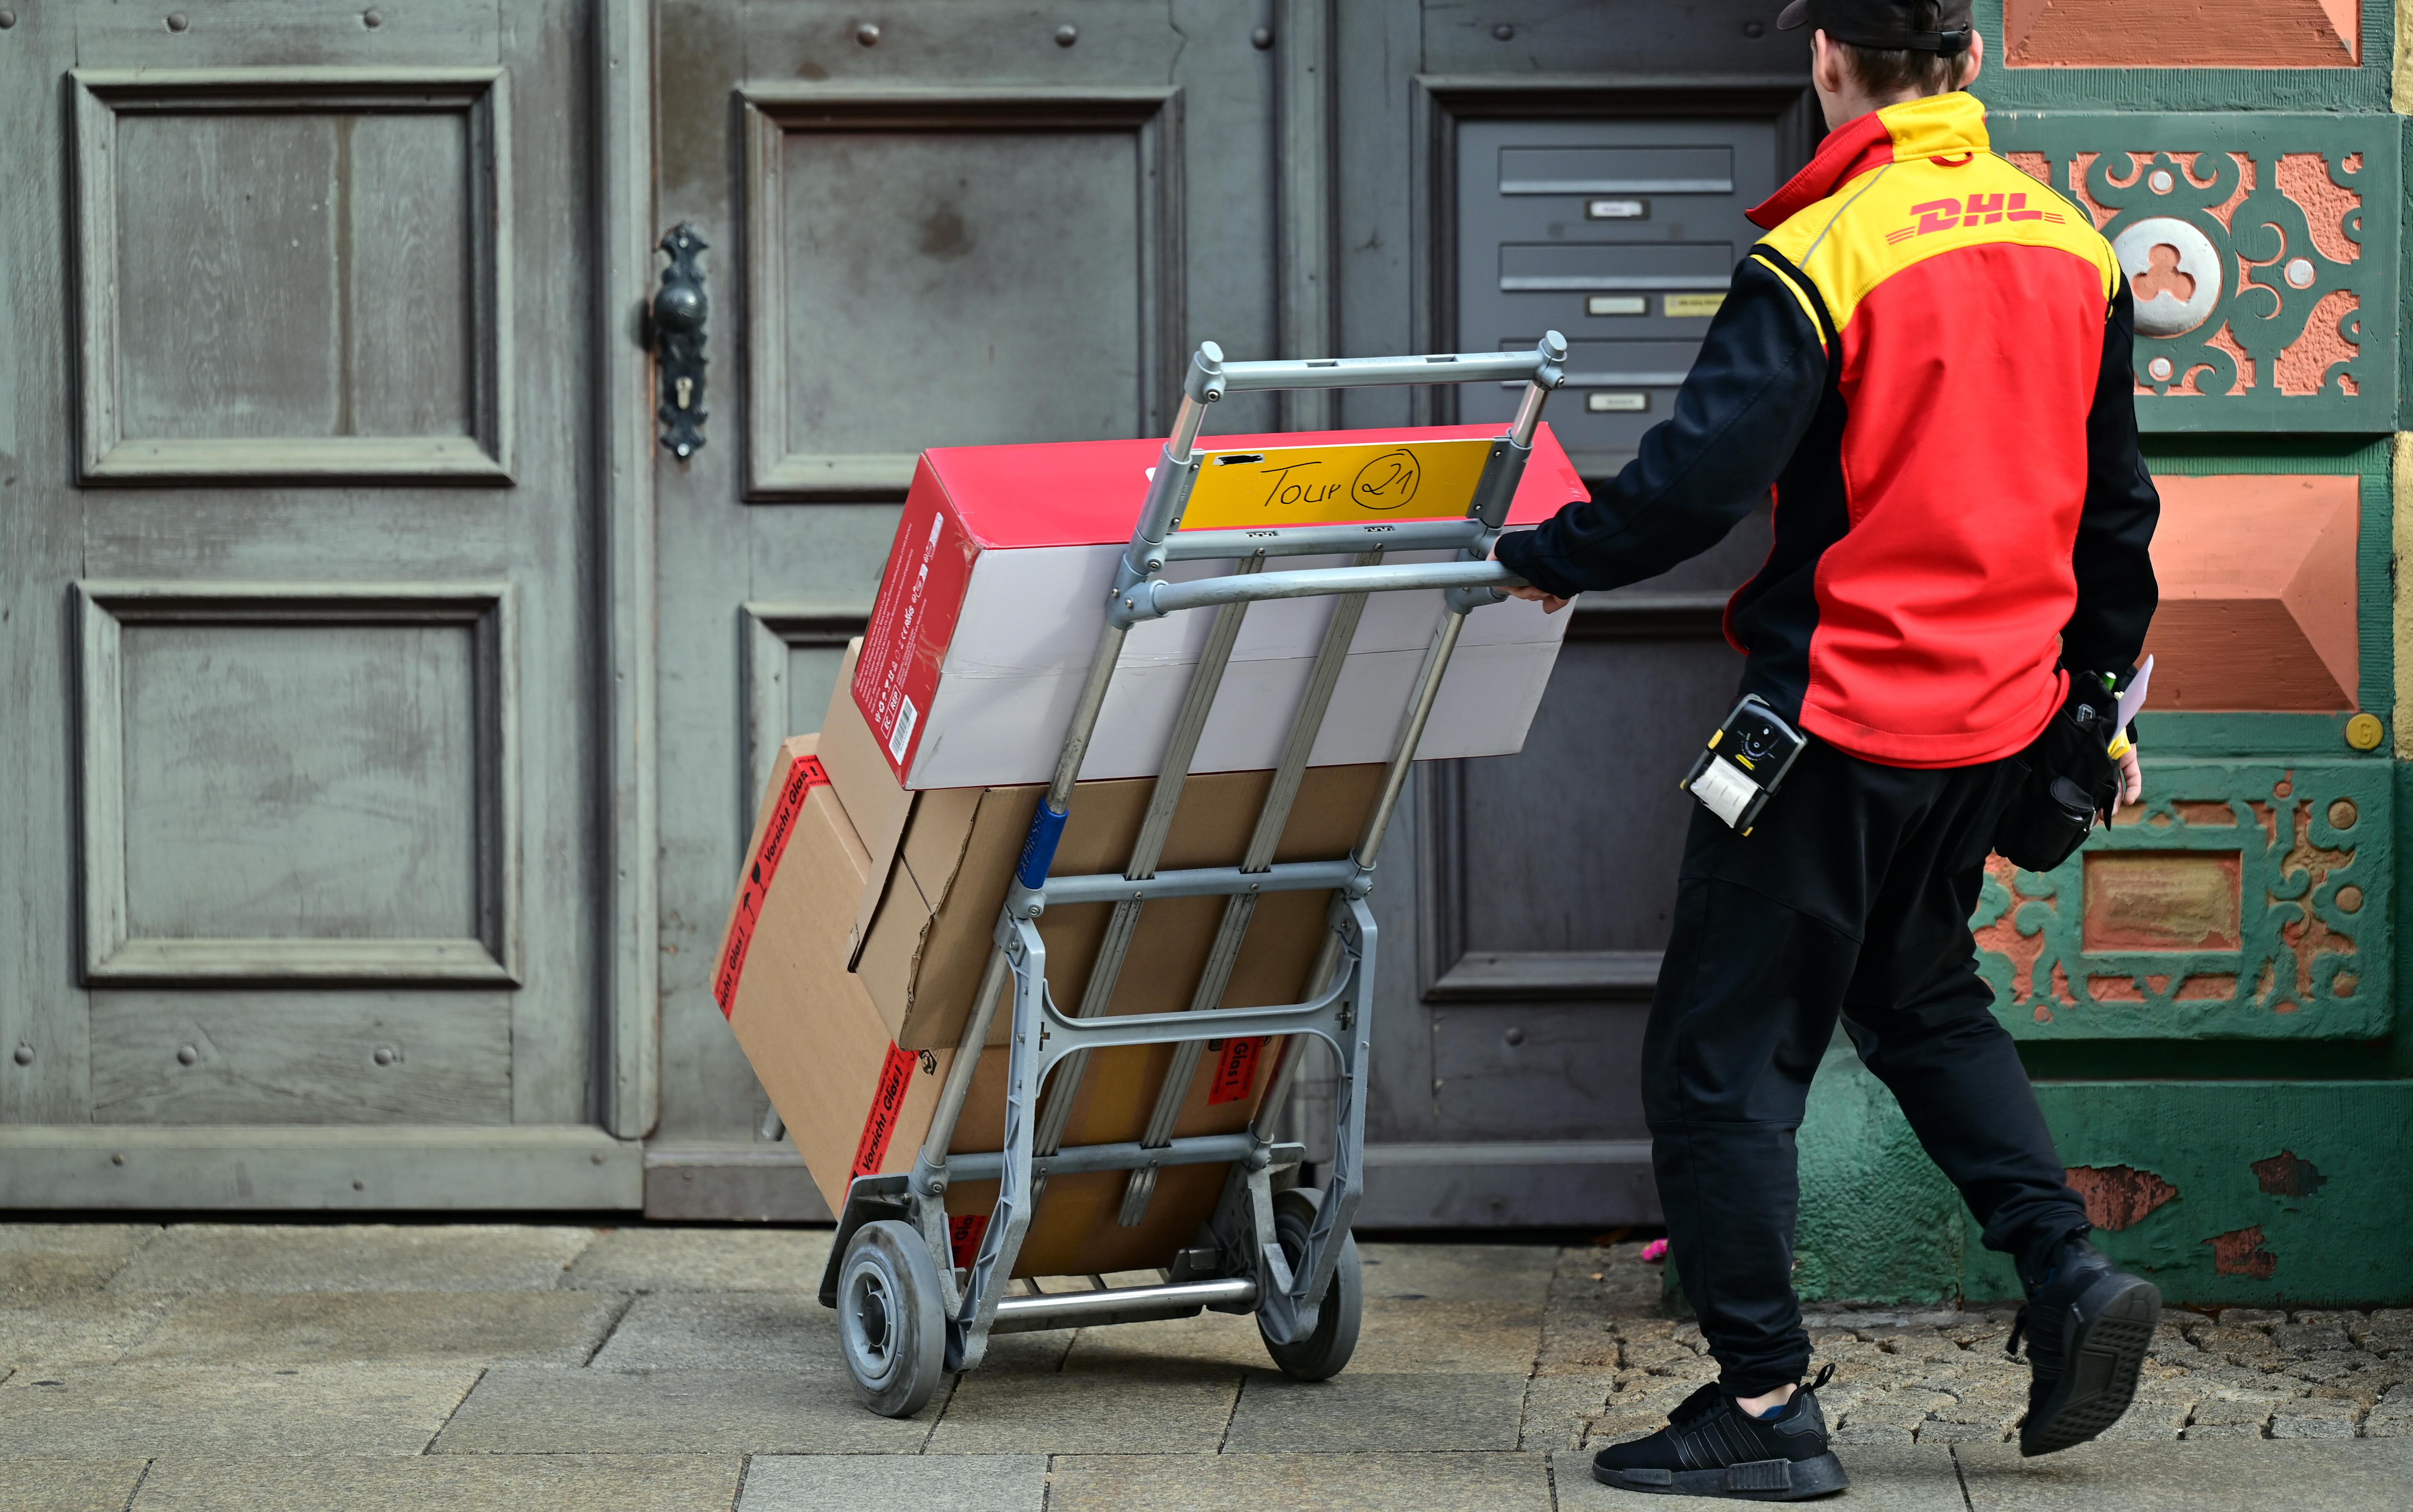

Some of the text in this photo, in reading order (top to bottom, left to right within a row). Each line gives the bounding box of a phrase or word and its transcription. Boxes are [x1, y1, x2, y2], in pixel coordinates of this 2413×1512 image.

[1910, 193, 2042, 236] DHL
[1261, 462, 1413, 507] Tour 21
[884, 691, 898, 730] EC REP
[765, 808, 790, 864] Vorsicht
[789, 770, 808, 806] Glas
[729, 937, 743, 971] Glas
[1228, 1043, 1249, 1078] Glas
[862, 1113, 886, 1171] Vorsicht
[884, 1074, 900, 1111] Glas
[954, 1215, 974, 1240] Gla
